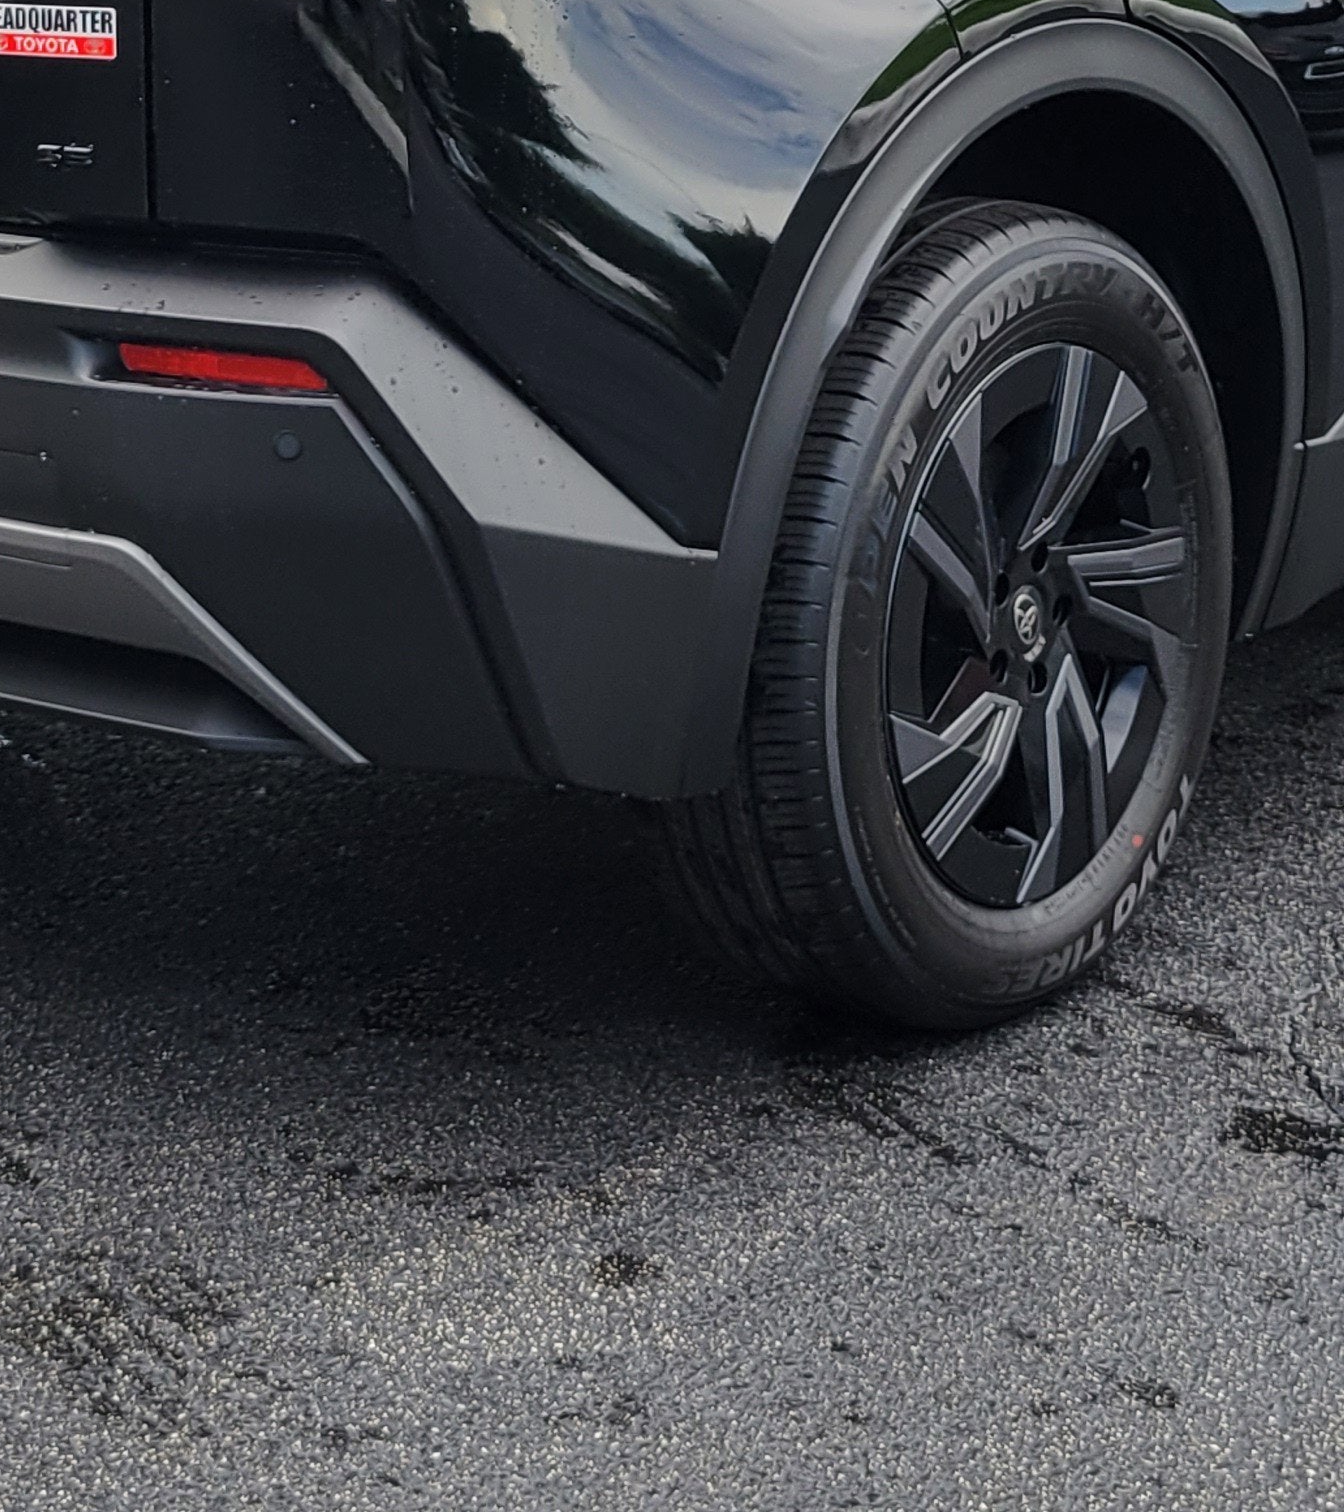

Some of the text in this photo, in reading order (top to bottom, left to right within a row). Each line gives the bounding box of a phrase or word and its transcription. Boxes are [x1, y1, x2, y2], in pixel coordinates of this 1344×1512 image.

[13, 35, 79, 53] TOYOTA
[926, 261, 1119, 410] COUNTRY
[1112, 773, 1196, 934] TOYO
